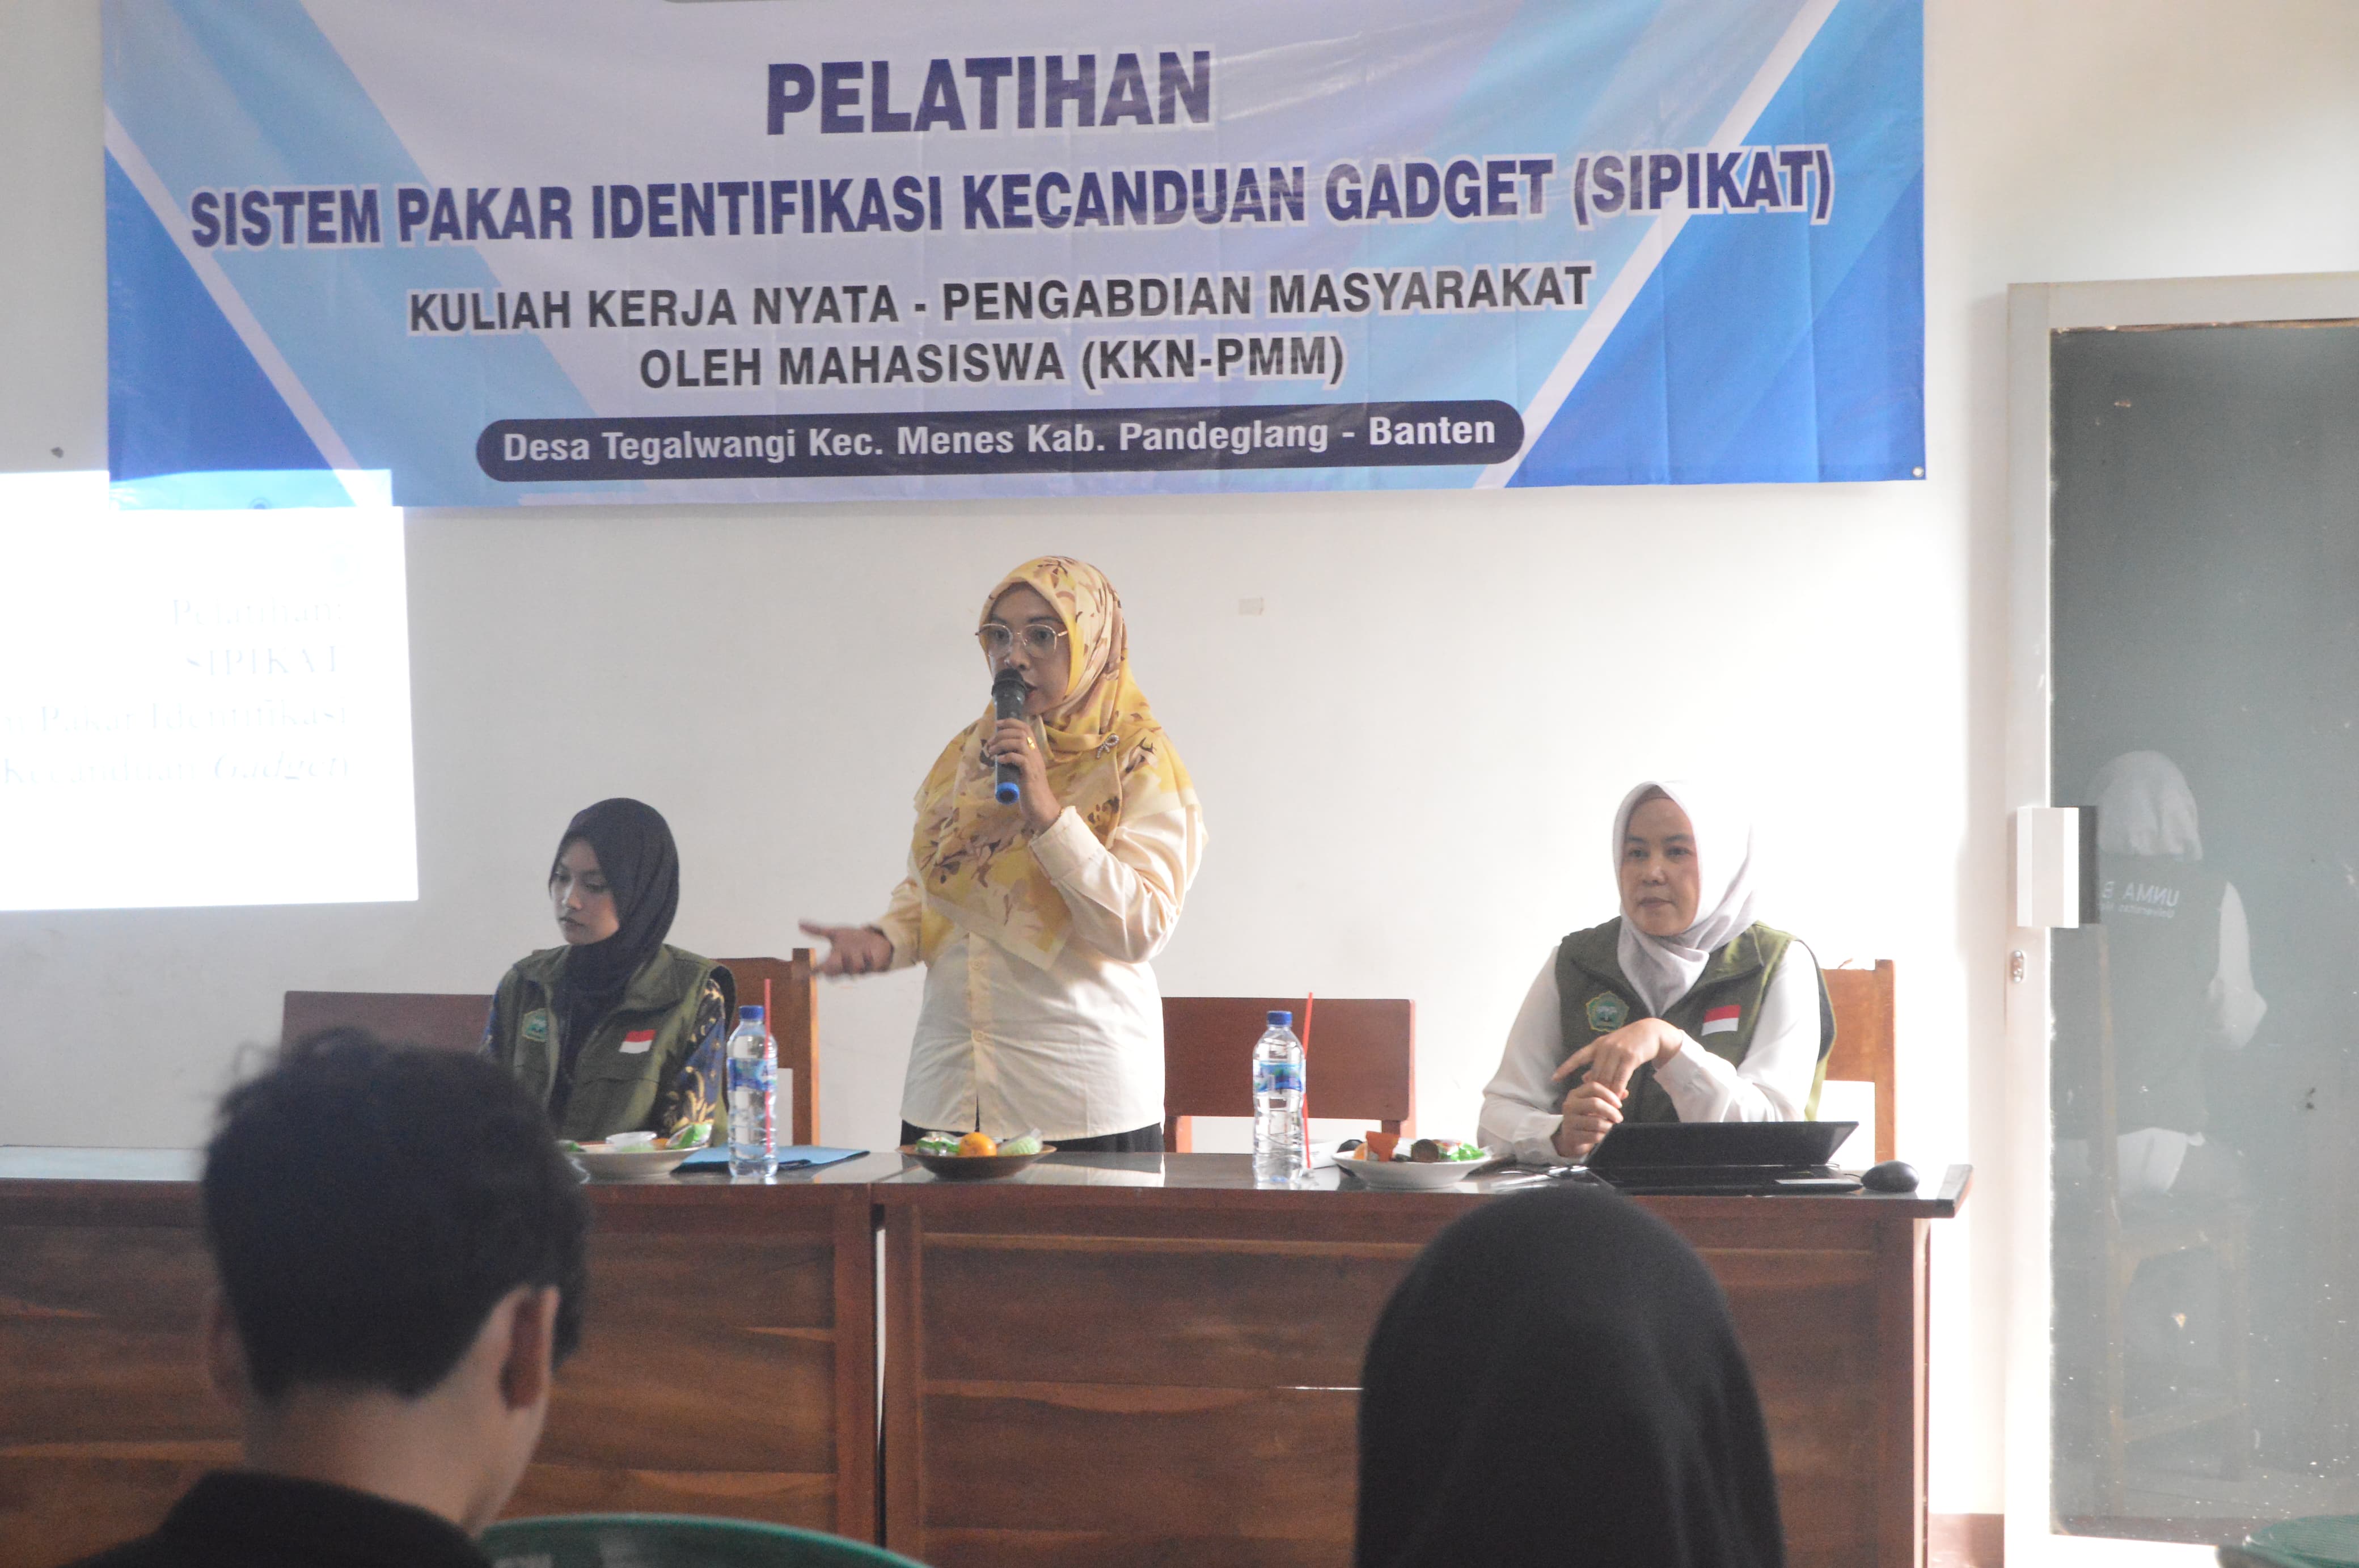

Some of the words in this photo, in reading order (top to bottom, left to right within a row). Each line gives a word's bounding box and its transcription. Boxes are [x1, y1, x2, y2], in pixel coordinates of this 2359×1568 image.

[767, 50, 1210, 136] PELATIHAN
[191, 189, 380, 248] SISTEM
[398, 186, 572, 242] PAKAR
[592, 175, 942, 239] IDENTIFIKASI
[963, 166, 1304, 230] KECANDUAN
[1325, 159, 1553, 221] GADGET
[1574, 150, 1831, 226] (SIPIKAT)
[411, 290, 570, 332] KULIAH
[589, 289, 737, 328] KERJA
[754, 285, 899, 325] NYATA
[914, 303, 927, 312] -
[943, 276, 1250, 321] PENGABDIAN
[1270, 265, 1592, 314] MASYARAKAT
[640, 348, 760, 388] OLEH
[780, 342, 1064, 385] MAHASISWA
[1082, 336, 1343, 390] (KKN-PMM)
[504, 433, 590, 461] Desa
[601, 428, 796, 466] Tegalwangi
[809, 428, 883, 456] Kec.
[898, 426, 1014, 454] Menes
[1028, 423, 1105, 452] Kab.
[1120, 420, 1328, 455] Pandeglang
[1369, 416, 1495, 445] Banten
